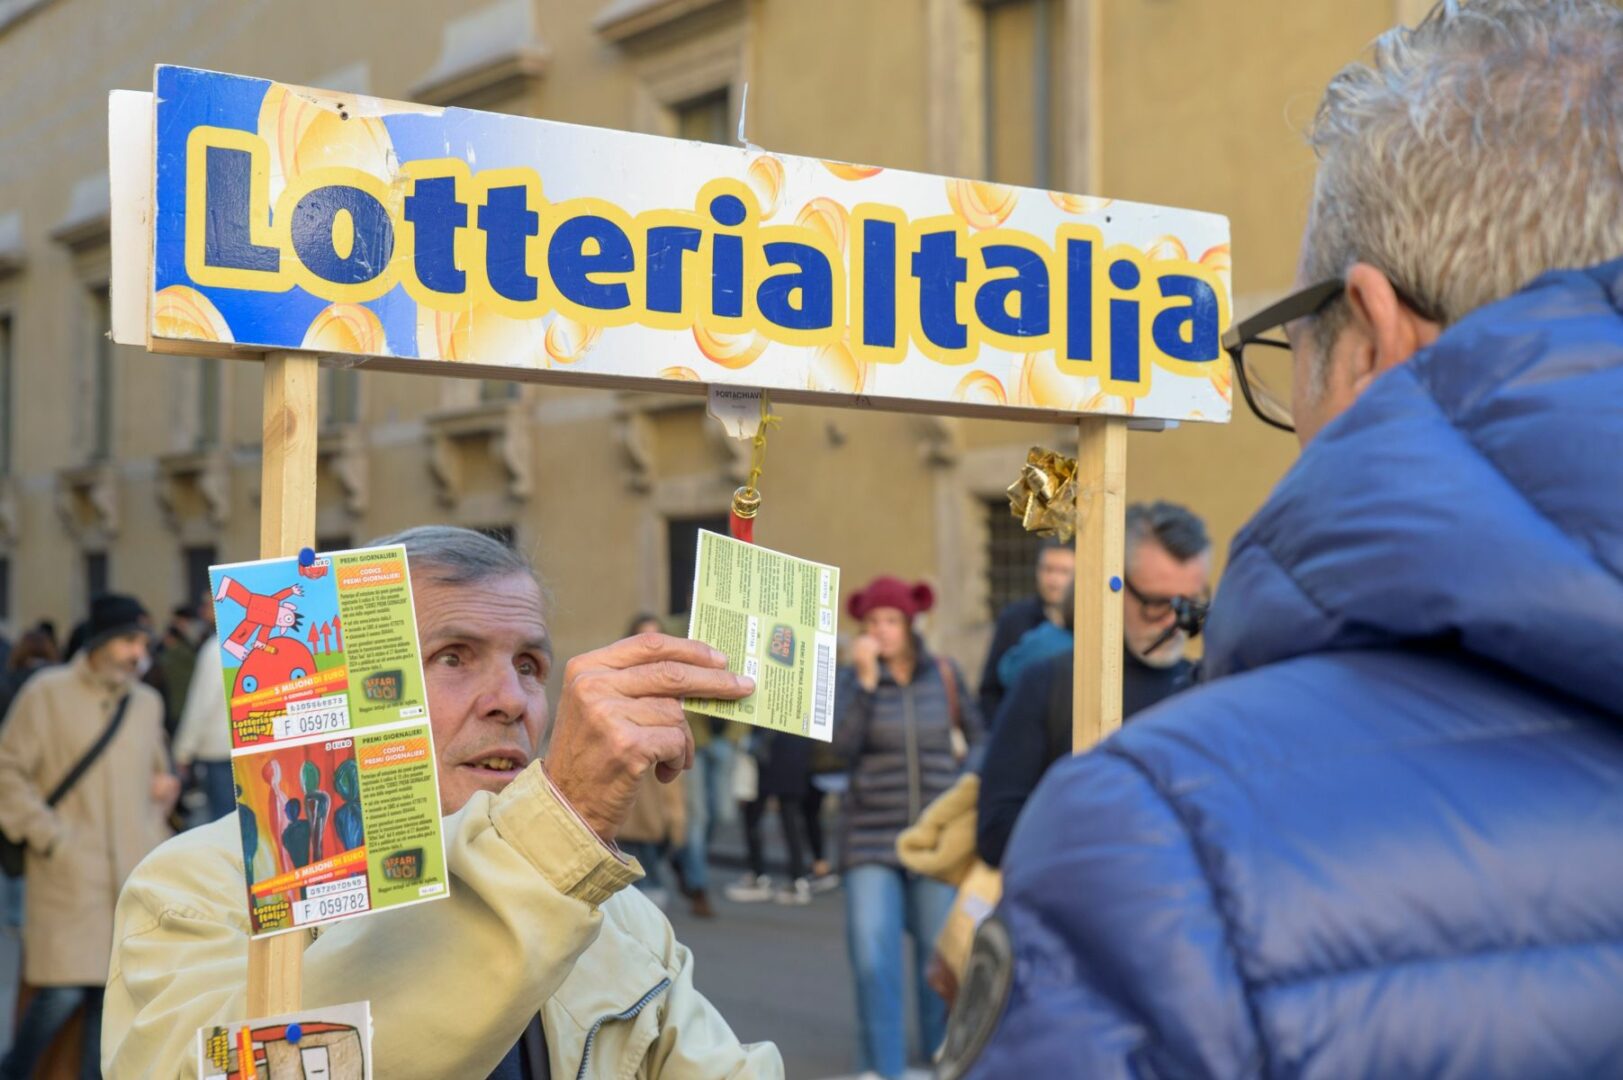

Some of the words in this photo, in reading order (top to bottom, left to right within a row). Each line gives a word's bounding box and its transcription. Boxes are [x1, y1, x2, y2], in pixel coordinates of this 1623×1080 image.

[340, 556, 358, 564] PREMI
[360, 552, 397, 563] GIORNALIERI
[343, 577, 362, 585] PREMI
[363, 572, 400, 583] GIORNALIERI
[281, 678, 313, 694] MILIONI
[324, 670, 346, 682] EURO
[232, 716, 271, 729] Lotteria
[284, 720, 290, 735] F
[299, 712, 346, 733] 059781
[238, 723, 267, 737] Italia
[362, 735, 382, 744] PREMI
[383, 728, 422, 742] GIORNALIERI
[364, 756, 384, 765] PREMI
[385, 750, 425, 762] GIORNALIERI
[301, 860, 334, 877] MILIONI
[253, 901, 289, 915] Lotteria
[304, 904, 310, 919] F
[319, 896, 364, 916] 059782
[259, 910, 286, 923] Italia
